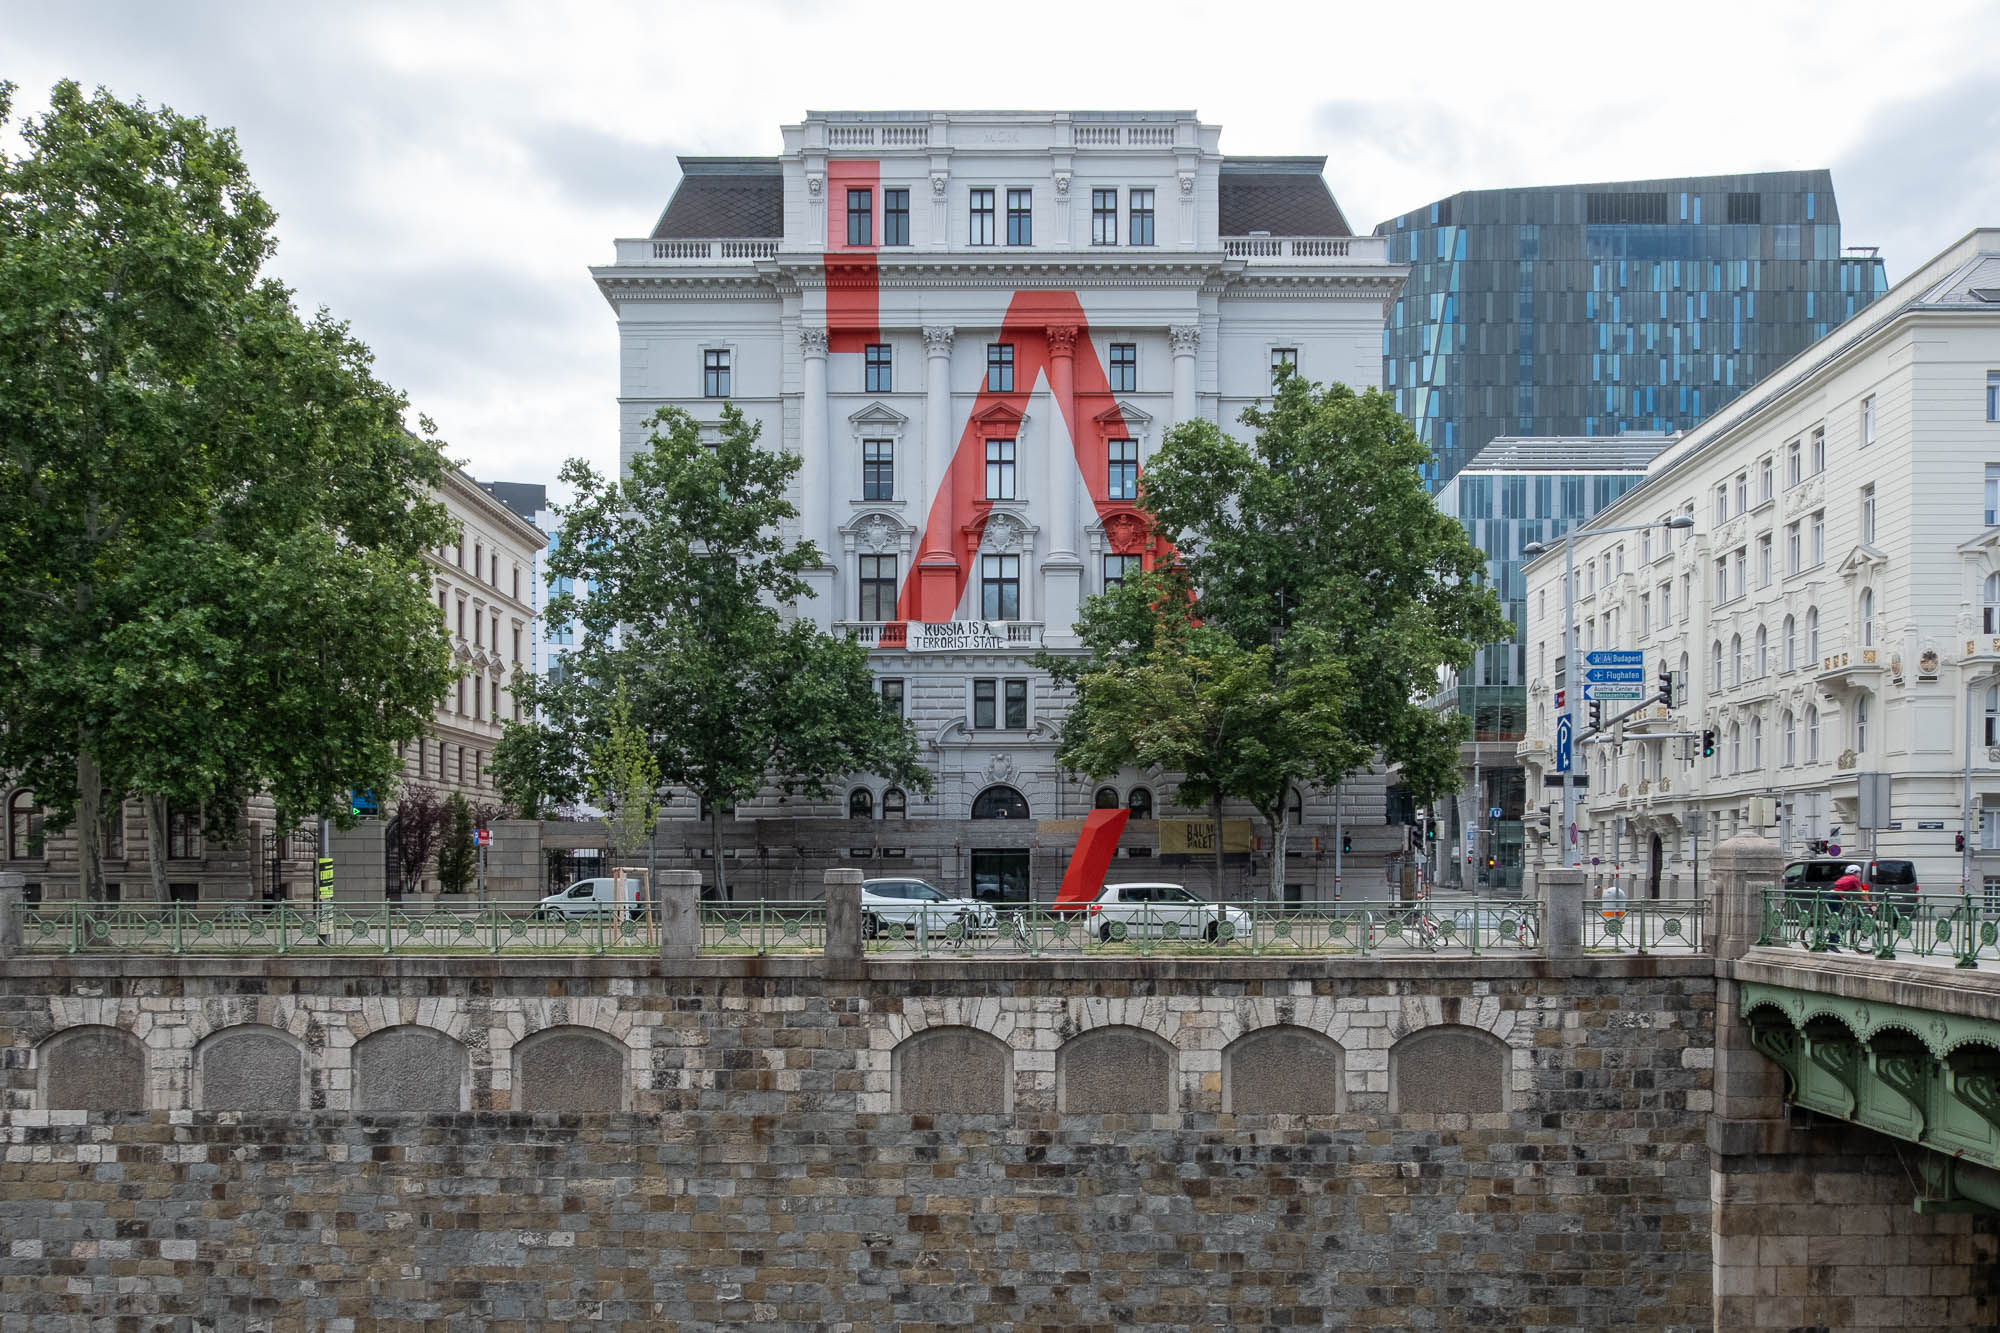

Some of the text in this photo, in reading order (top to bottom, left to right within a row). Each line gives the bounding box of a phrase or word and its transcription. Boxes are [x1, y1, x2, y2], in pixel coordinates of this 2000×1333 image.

[924, 621, 991, 636] RUSSIA IS A
[914, 636, 1004, 648] TERRORIST STATE
[1613, 654, 1641, 664] Budapest
[1606, 671, 1640, 681] Flughafen
[1561, 726, 1568, 754] P
